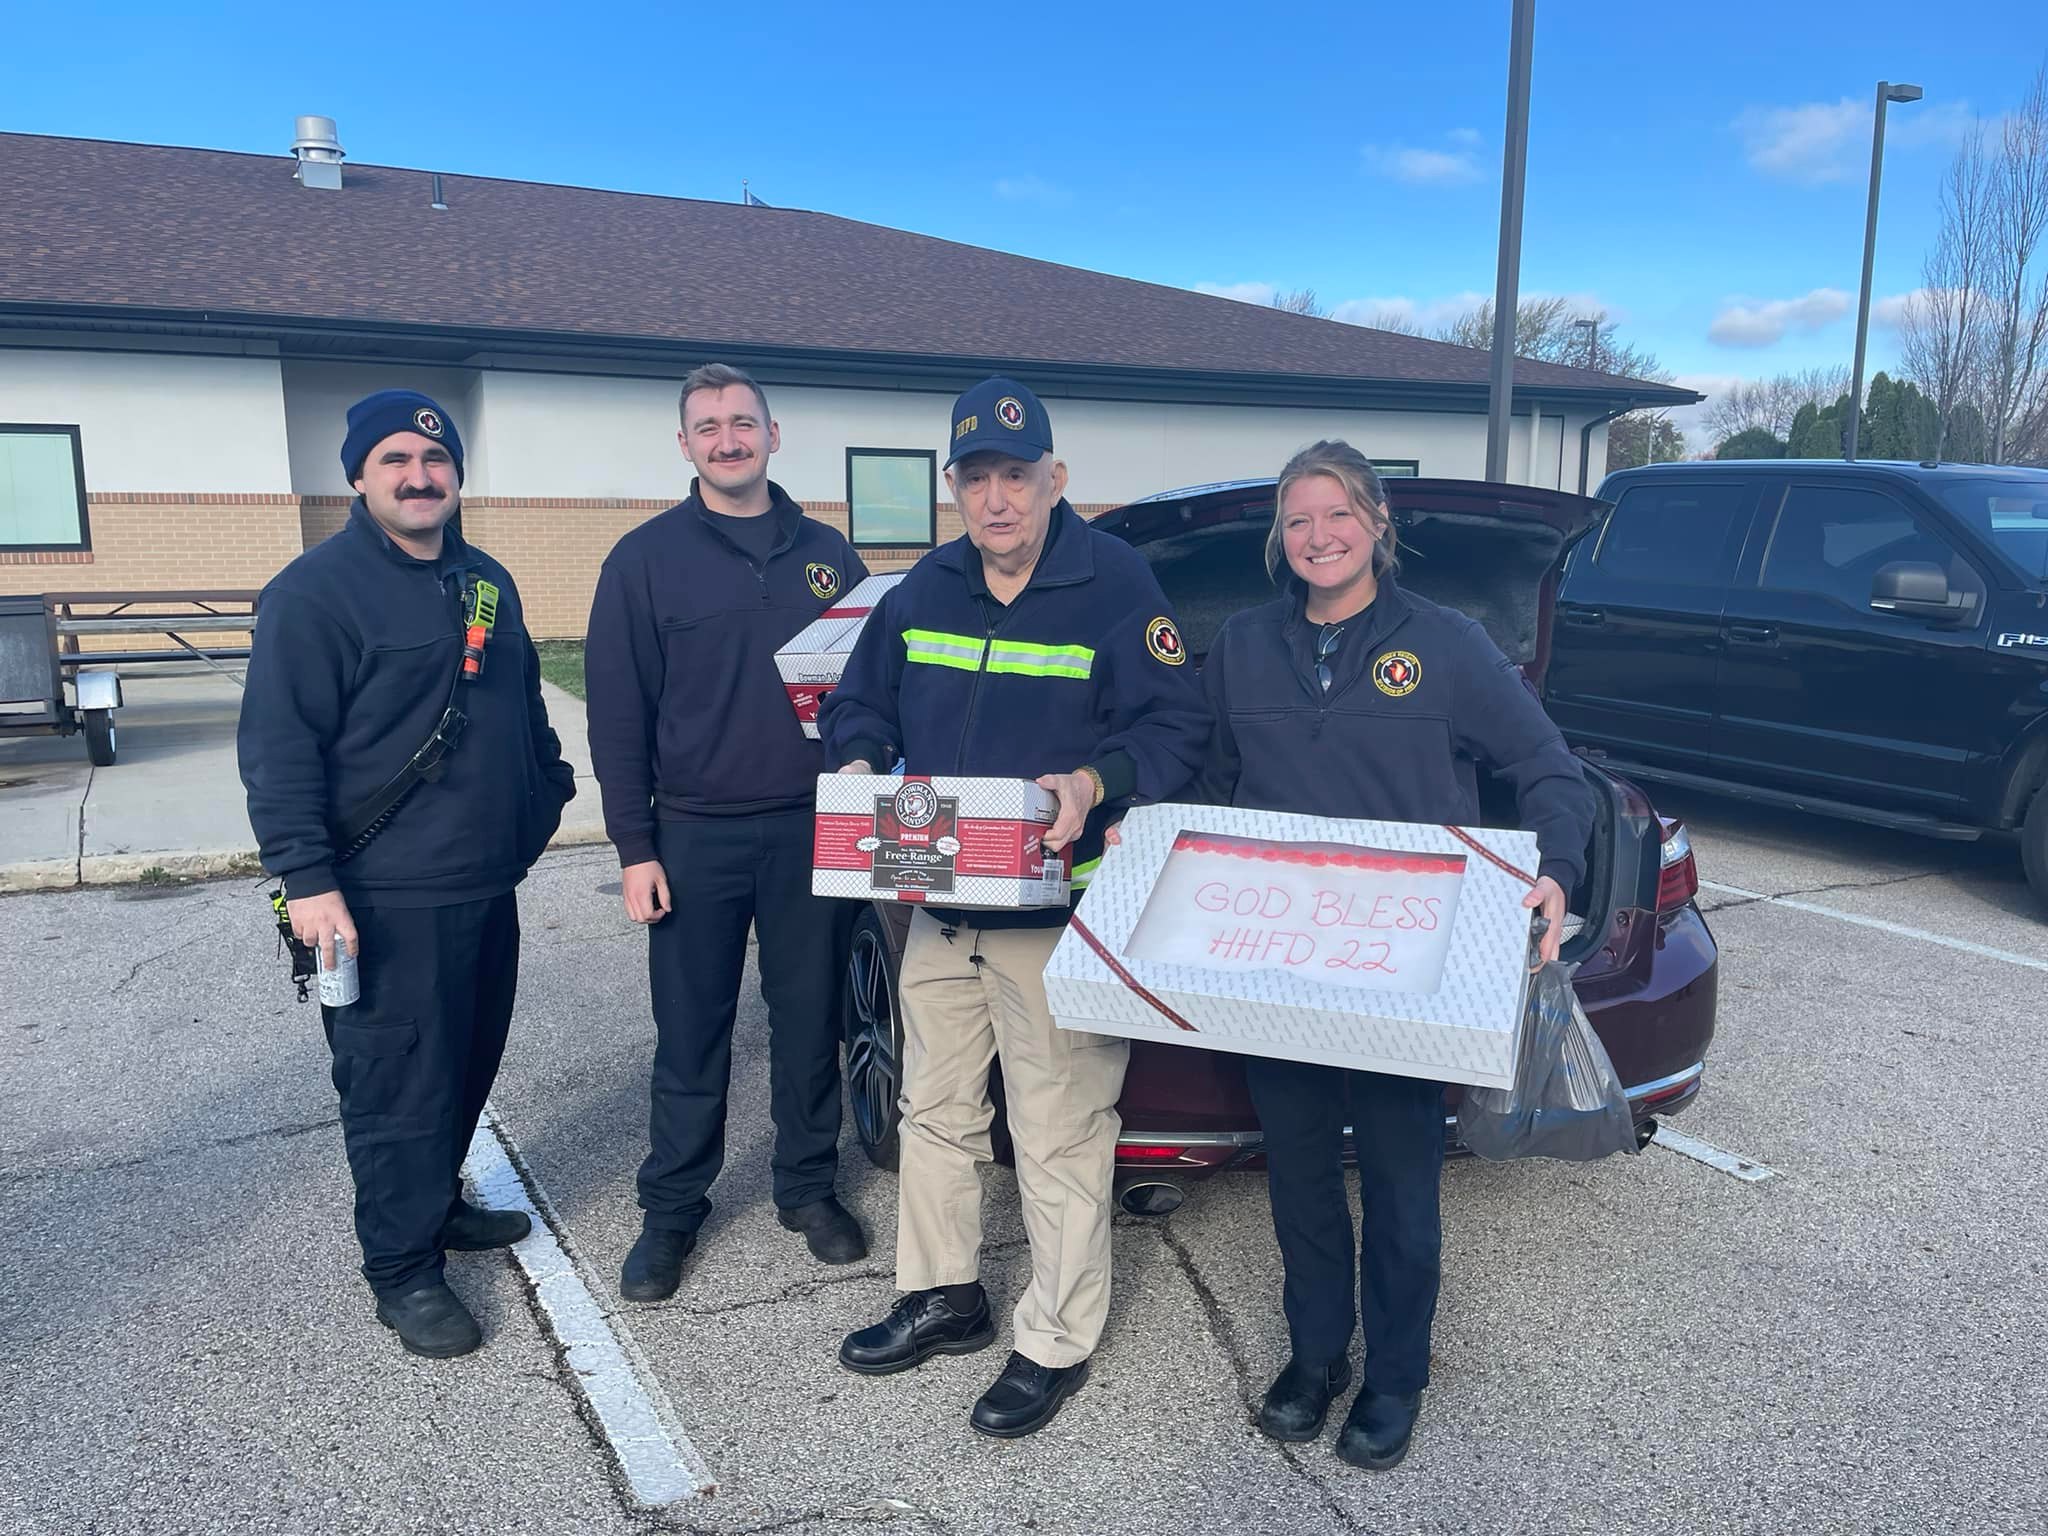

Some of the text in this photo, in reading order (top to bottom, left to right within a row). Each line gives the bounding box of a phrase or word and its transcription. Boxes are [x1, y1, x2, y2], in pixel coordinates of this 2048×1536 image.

[900, 784, 933, 801] BOWMAN
[901, 812, 930, 825] LANDES
[901, 832, 929, 841] PREMIUM
[1194, 881, 1442, 931] GOD BLESS
[1208, 927, 1397, 974] HHFD 22
